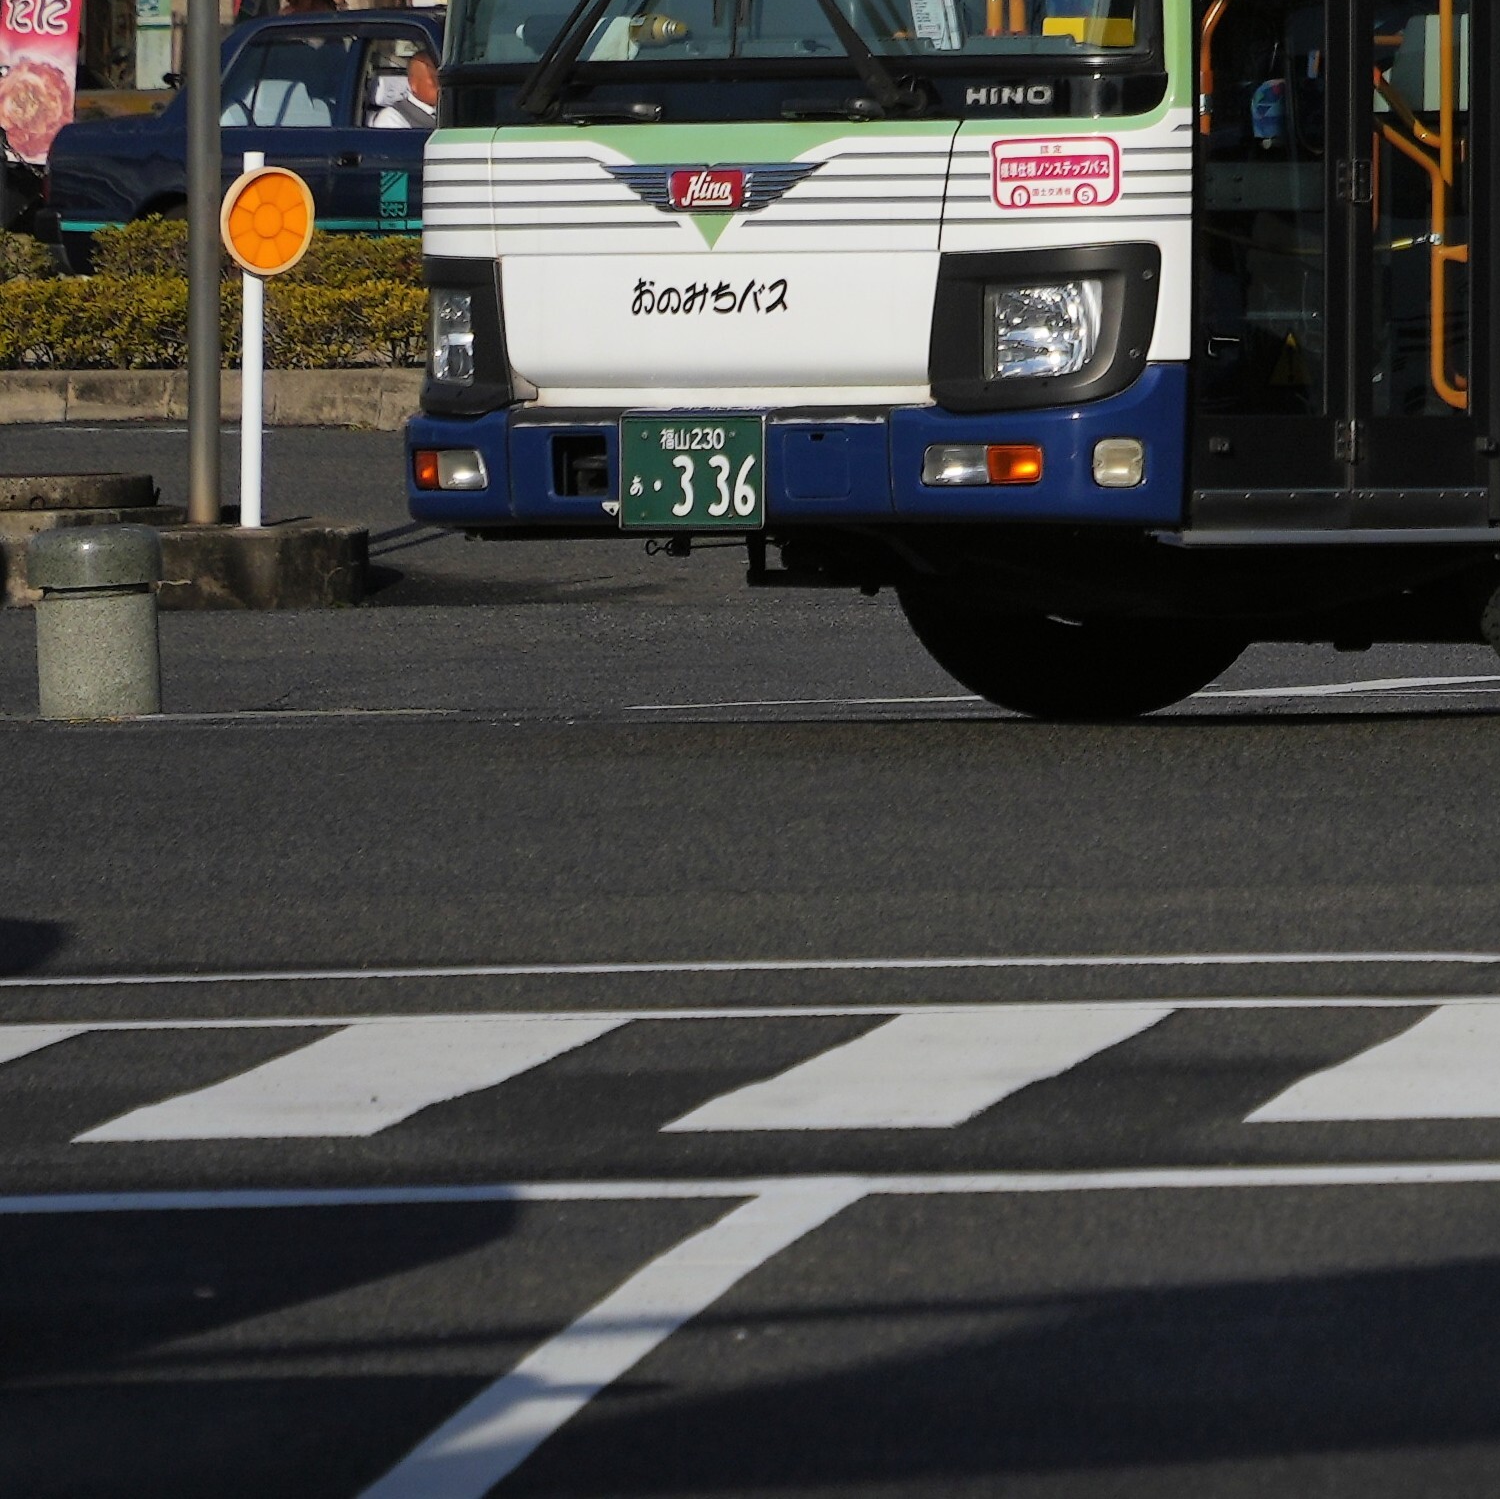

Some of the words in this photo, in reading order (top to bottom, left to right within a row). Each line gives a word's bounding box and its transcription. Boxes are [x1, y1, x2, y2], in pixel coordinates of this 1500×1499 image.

[965, 85, 1053, 106] HINO
[681, 171, 733, 207] Hino
[631, 277, 789, 317] おのみちバス
